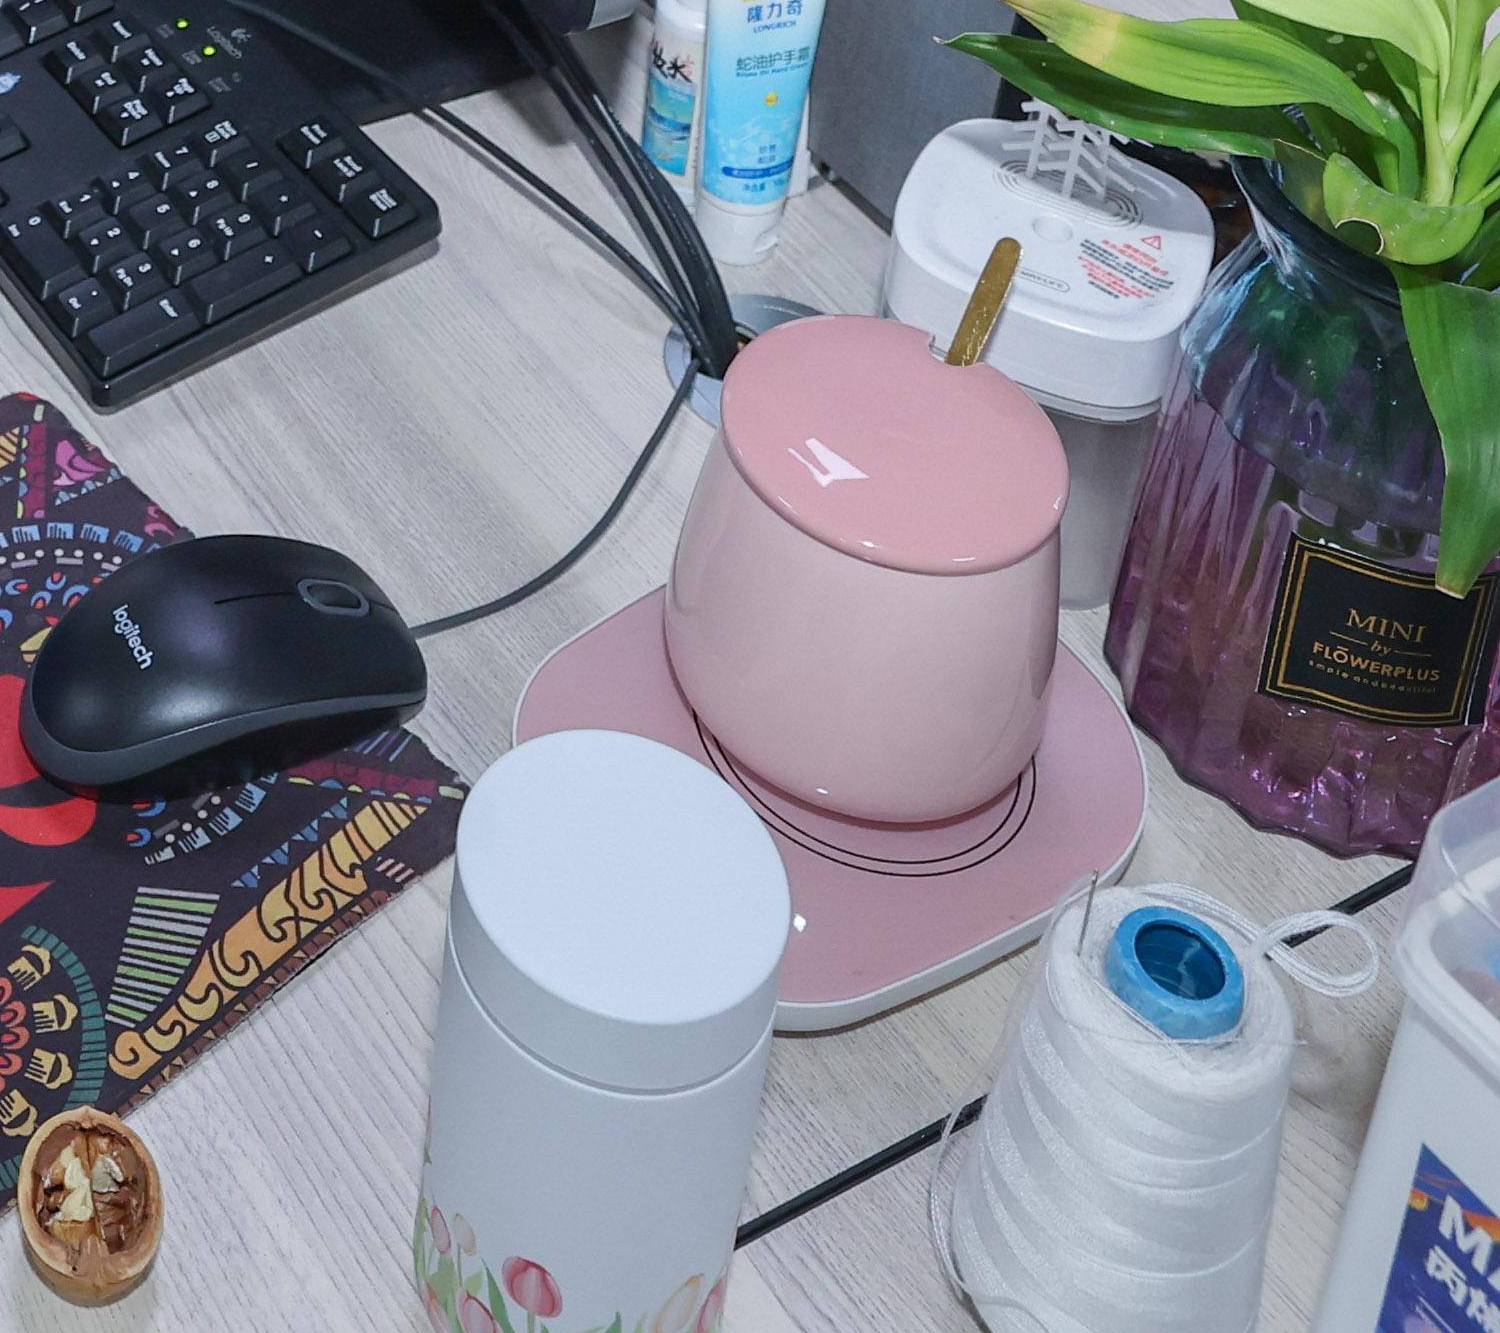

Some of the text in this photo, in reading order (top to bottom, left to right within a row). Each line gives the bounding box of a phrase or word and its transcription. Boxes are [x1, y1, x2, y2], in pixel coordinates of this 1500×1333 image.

[747, 0, 804, 23] 隆力奇
[753, 20, 797, 33] LONGRICH
[206, 26, 243, 60] Logitech
[736, 46, 811, 71] 蛇油护手霜
[111, 603, 154, 671] logitech
[1346, 608, 1427, 643] MINI
[1371, 640, 1391, 656] by
